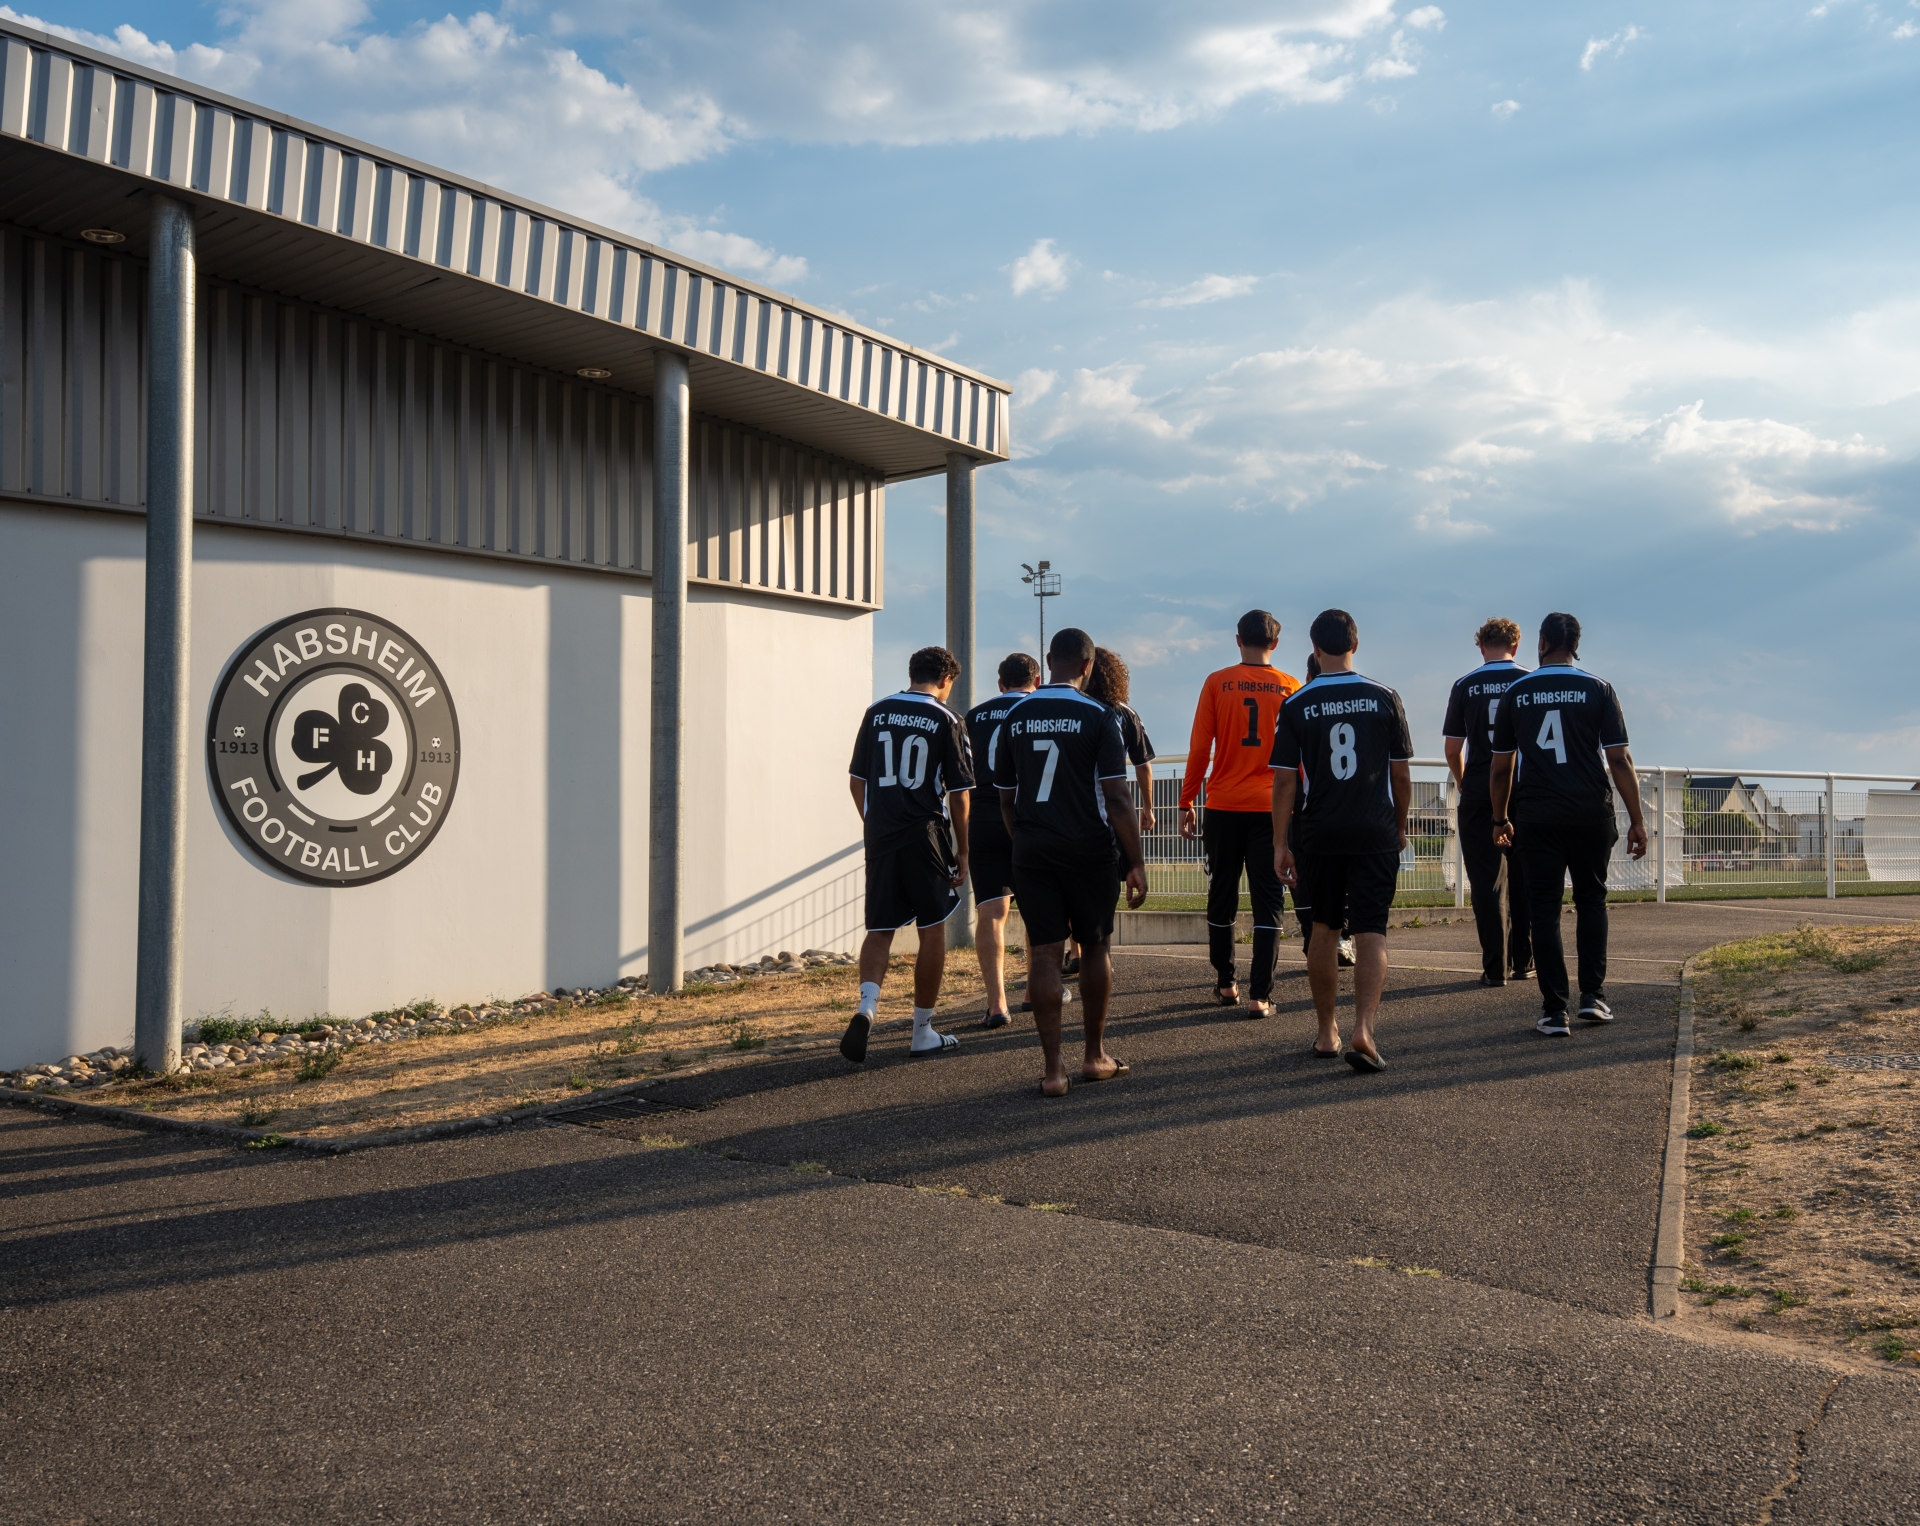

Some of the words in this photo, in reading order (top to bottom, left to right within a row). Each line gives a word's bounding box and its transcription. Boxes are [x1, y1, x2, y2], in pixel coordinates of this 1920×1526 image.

[244, 624, 436, 708] HABSHEIM
[1223, 681, 1234, 692] FC
[1238, 681, 1286, 694] HABSHEIM
[1469, 685, 1480, 696] FC
[1304, 705, 1319, 720] FC
[1322, 699, 1378, 715] HABSHEIM
[1517, 694, 1529, 707] FC
[1533, 691, 1586, 704] HABSHEIM
[352, 702, 369, 724] C
[873, 714, 885, 726] FC
[888, 713, 939, 734] HABSHEIM
[976, 711, 987, 722] FC
[1241, 698, 1261, 746] 1
[313, 728, 329, 749] F
[1011, 721, 1022, 737] FC
[1026, 719, 1081, 733] HABSHEIM
[1536, 710, 1567, 764] 4
[219, 742, 259, 754] 1913
[420, 752, 451, 764] 1913
[1329, 722, 1357, 780] 8
[357, 750, 375, 771] H
[878, 731, 928, 790] 10
[1033, 740, 1059, 802] 7
[231, 777, 379, 872] FOOTBALL
[385, 782, 442, 856] CLUB
